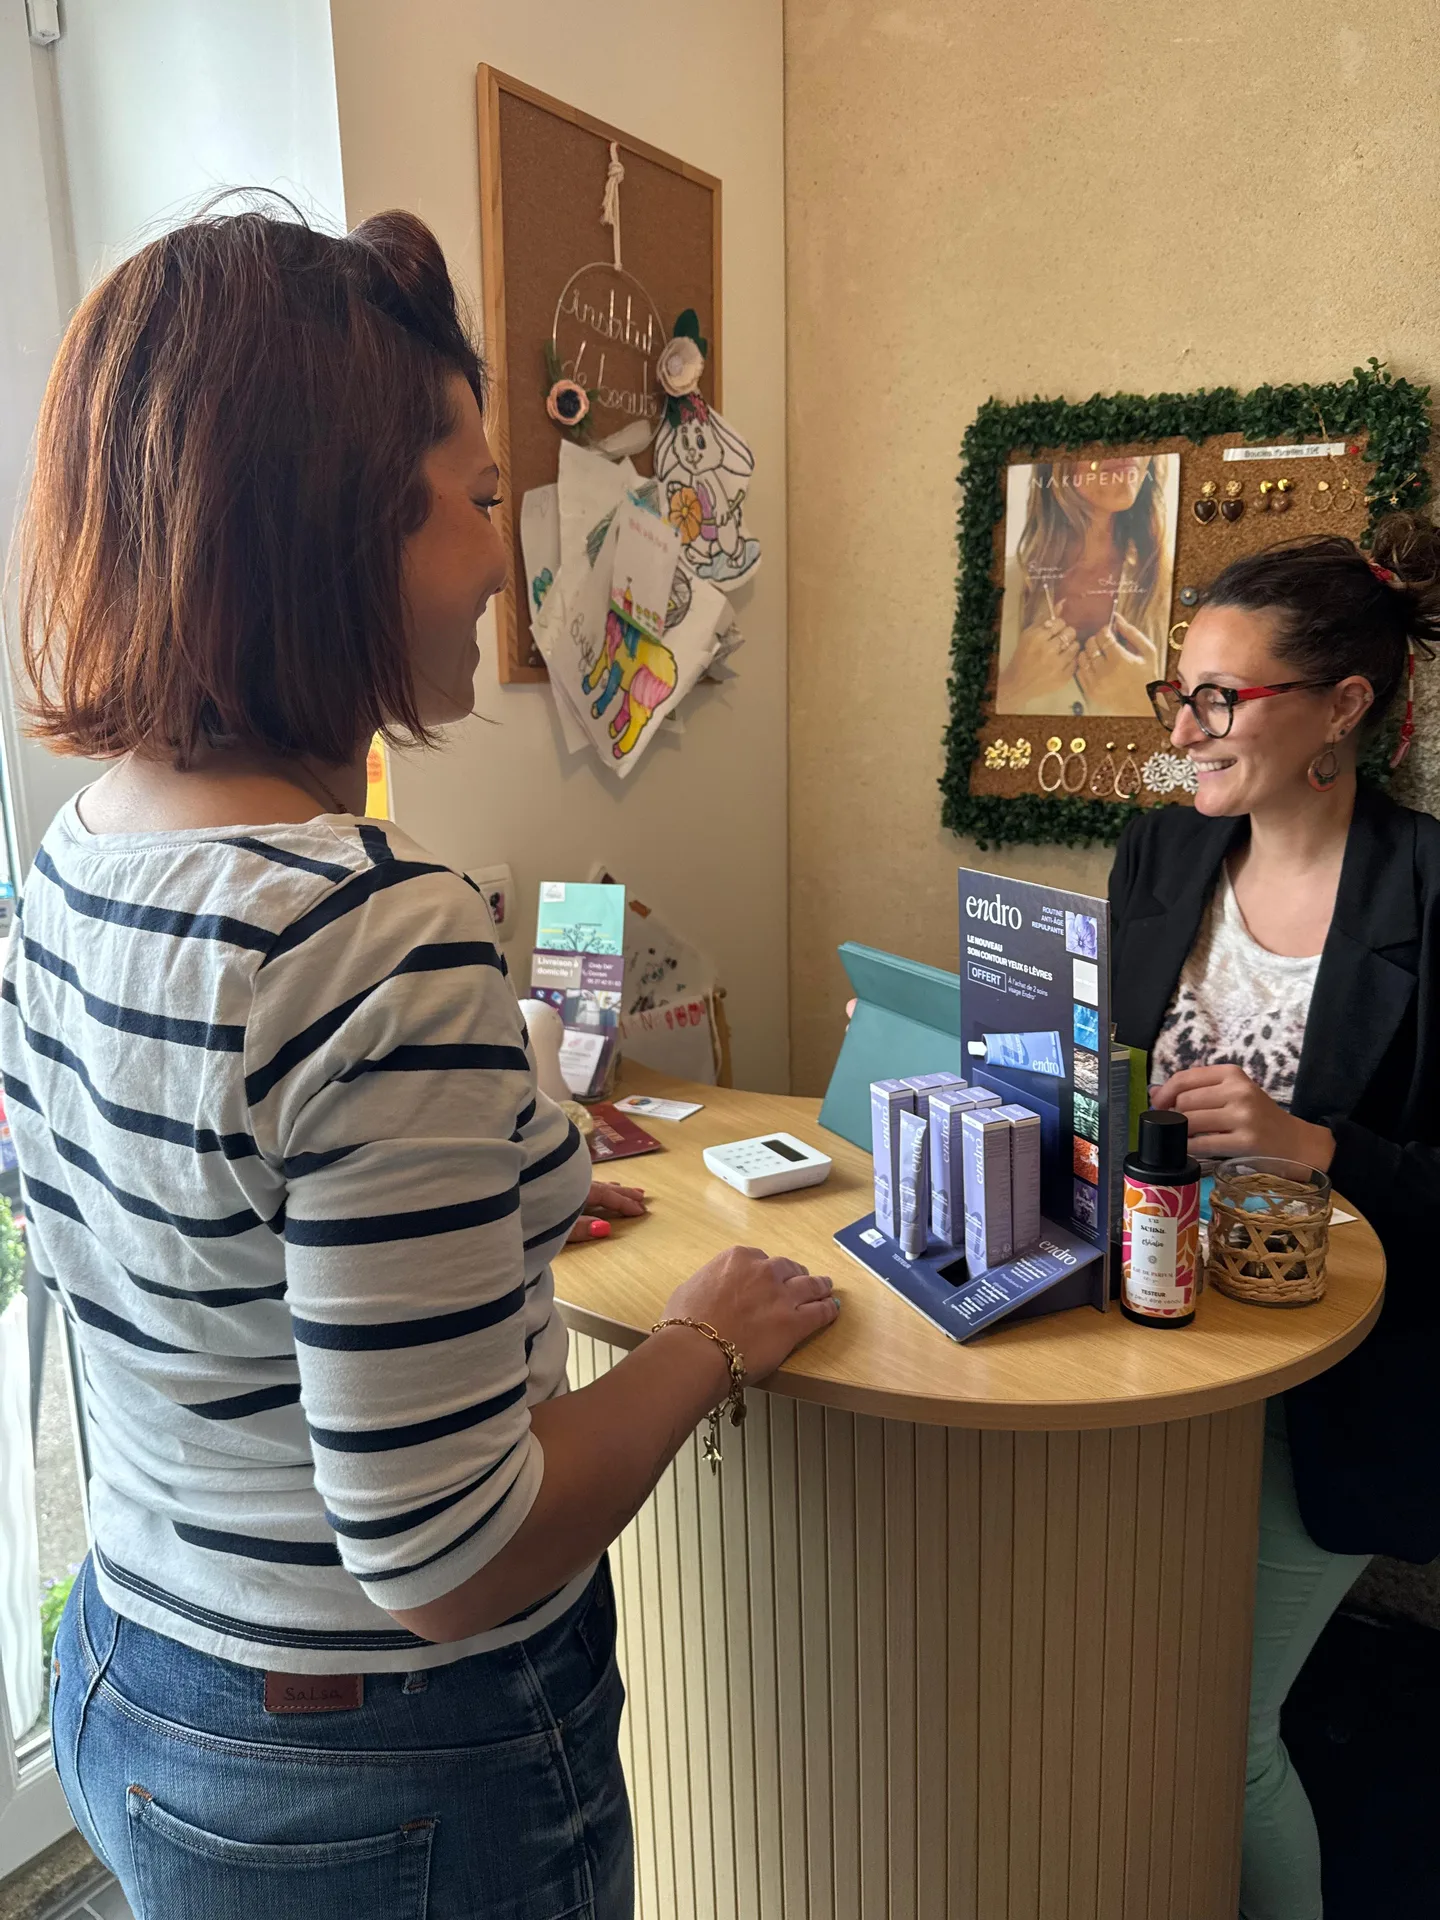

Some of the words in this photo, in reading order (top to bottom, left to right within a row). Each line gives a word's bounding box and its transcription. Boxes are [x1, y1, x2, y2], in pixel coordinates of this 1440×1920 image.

[1031, 468, 1153, 488] NAKUPENDA
[966, 894, 1022, 930] endro
[1042, 906, 1064, 917] ROUTINE
[967, 934, 975, 944] LE
[975, 937, 1003, 952] NOUVEAU
[537, 957, 573, 968] Livraison
[537, 966, 569, 978] domicile
[967, 946, 980, 957] SOIN
[980, 951, 1008, 966] CONTOUR
[1008, 959, 1023, 971] YEUX
[1029, 966, 1053, 981] LÈVRES
[971, 967, 1001, 985] OFFERT
[1026, 983, 1033, 991] de
[1032, 1058, 1060, 1074] endro
[881, 1106, 889, 1149] endro
[911, 1126, 923, 1173] endro
[941, 1118, 950, 1163] endro
[973, 1138, 984, 1185] endro
[1038, 1240, 1078, 1266] endro
[1141, 1288, 1166, 1297] TESTEUR
